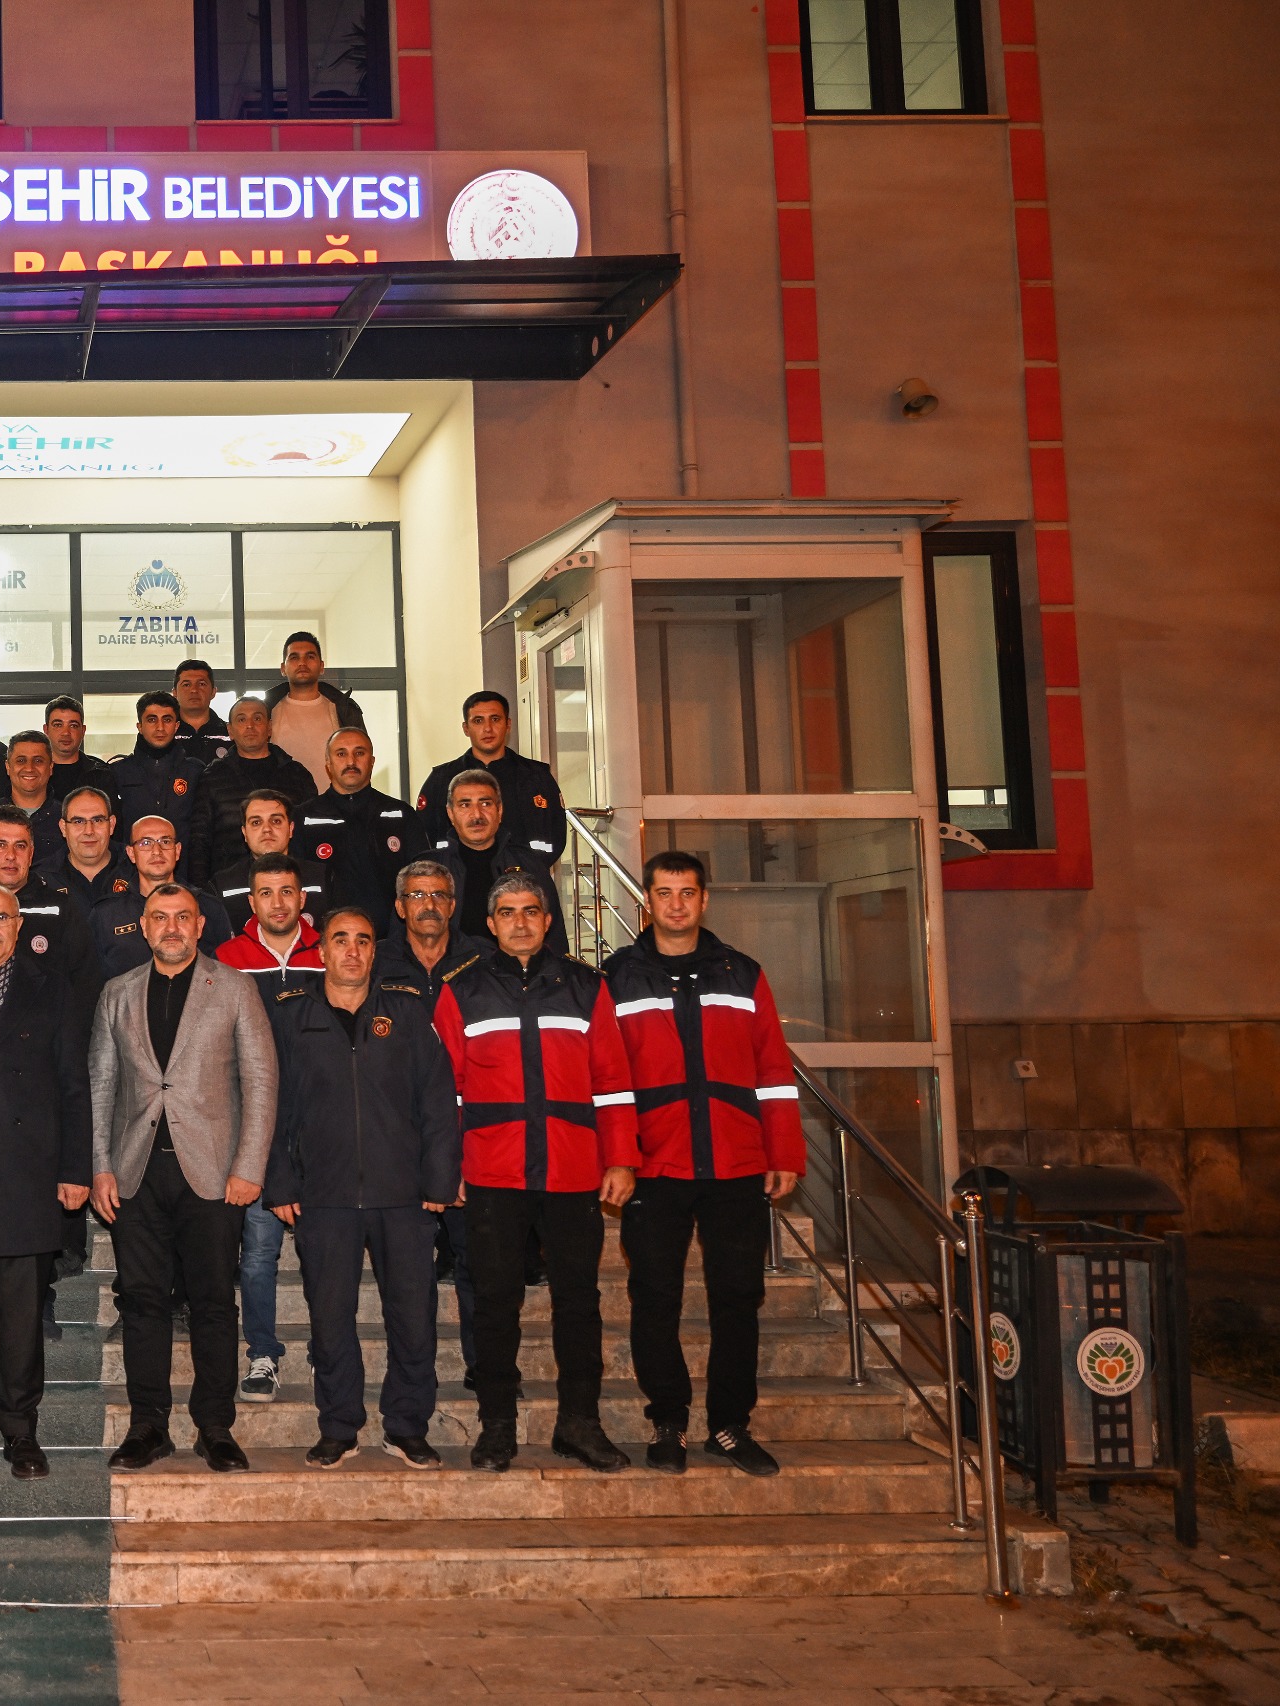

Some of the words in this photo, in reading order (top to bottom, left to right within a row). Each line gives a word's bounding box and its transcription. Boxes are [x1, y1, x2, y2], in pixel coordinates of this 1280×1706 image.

[163, 176, 420, 219] BELEDİYESİ
[118, 616, 199, 632] ZABITA
[98, 634, 136, 645] DAİRE
[140, 632, 220, 647] BAŞKANLIĞI
